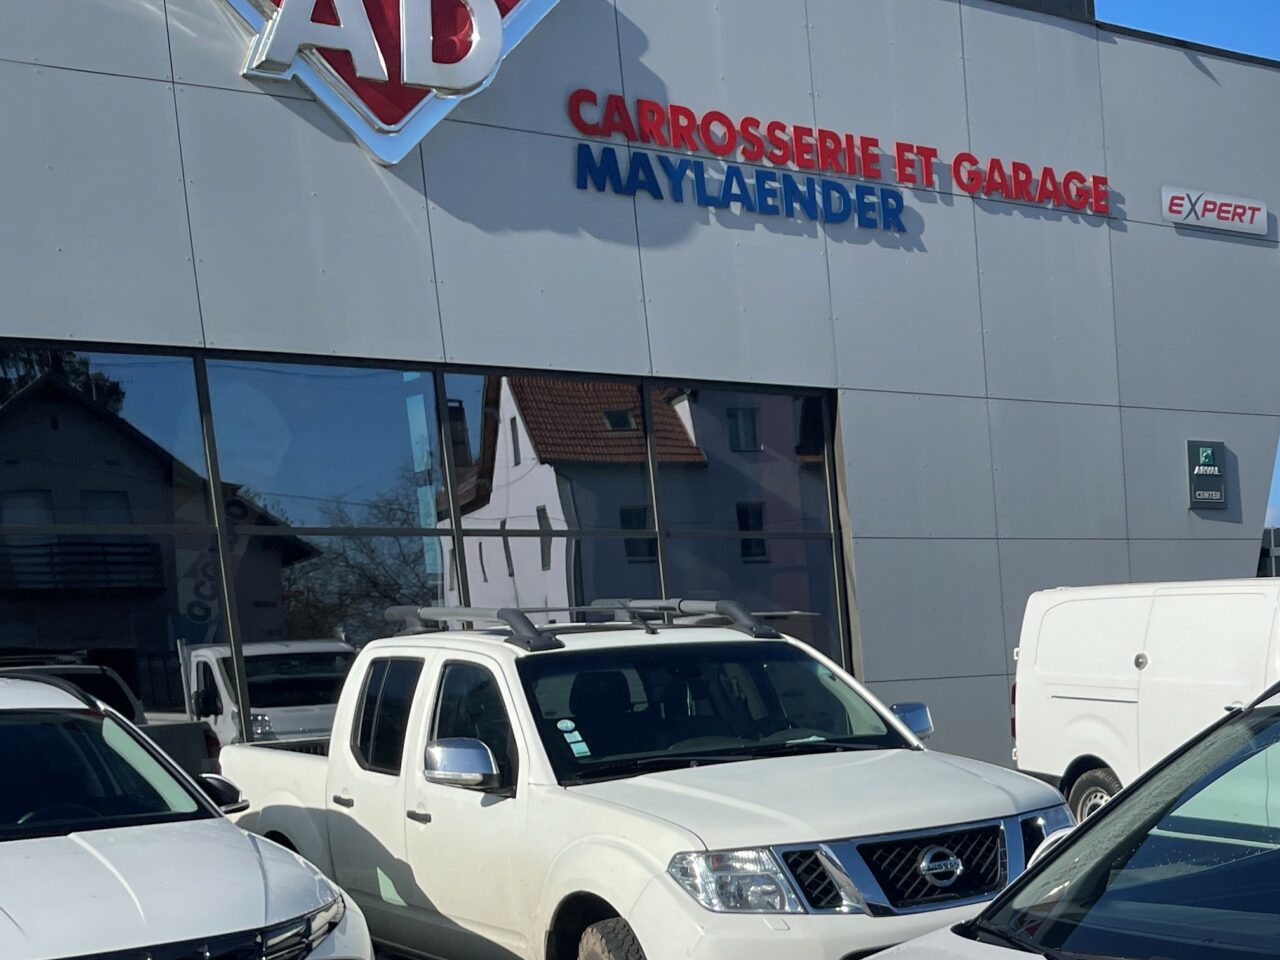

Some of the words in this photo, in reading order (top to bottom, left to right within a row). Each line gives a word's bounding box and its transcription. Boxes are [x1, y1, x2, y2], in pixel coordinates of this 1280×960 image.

[254, 0, 502, 89] AD
[567, 88, 882, 180] CARROSSERIE
[895, 141, 938, 187] ET
[952, 152, 1110, 214] GARAGE
[576, 143, 907, 233] MAYLAENDER
[1168, 192, 1262, 225] EXPERT
